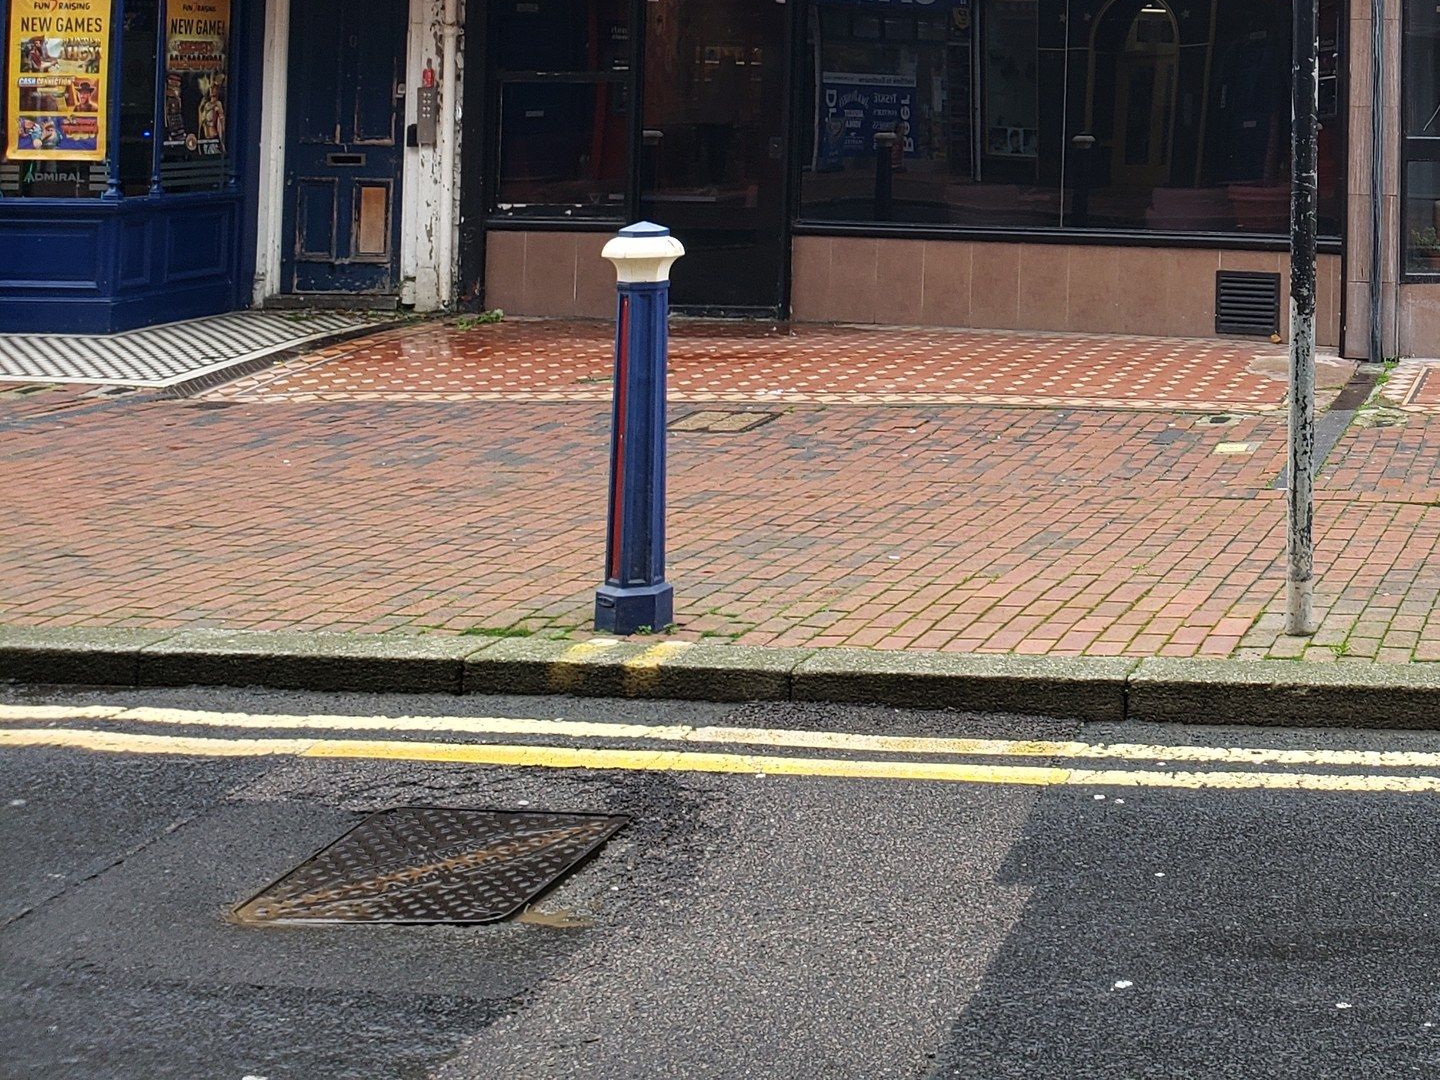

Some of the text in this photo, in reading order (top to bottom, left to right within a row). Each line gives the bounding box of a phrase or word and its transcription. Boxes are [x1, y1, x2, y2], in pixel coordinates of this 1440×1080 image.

[21, 17, 103, 33] NEW GAMES
[170, 19, 194, 35] NEW
[24, 163, 85, 183] ADMIRAL
